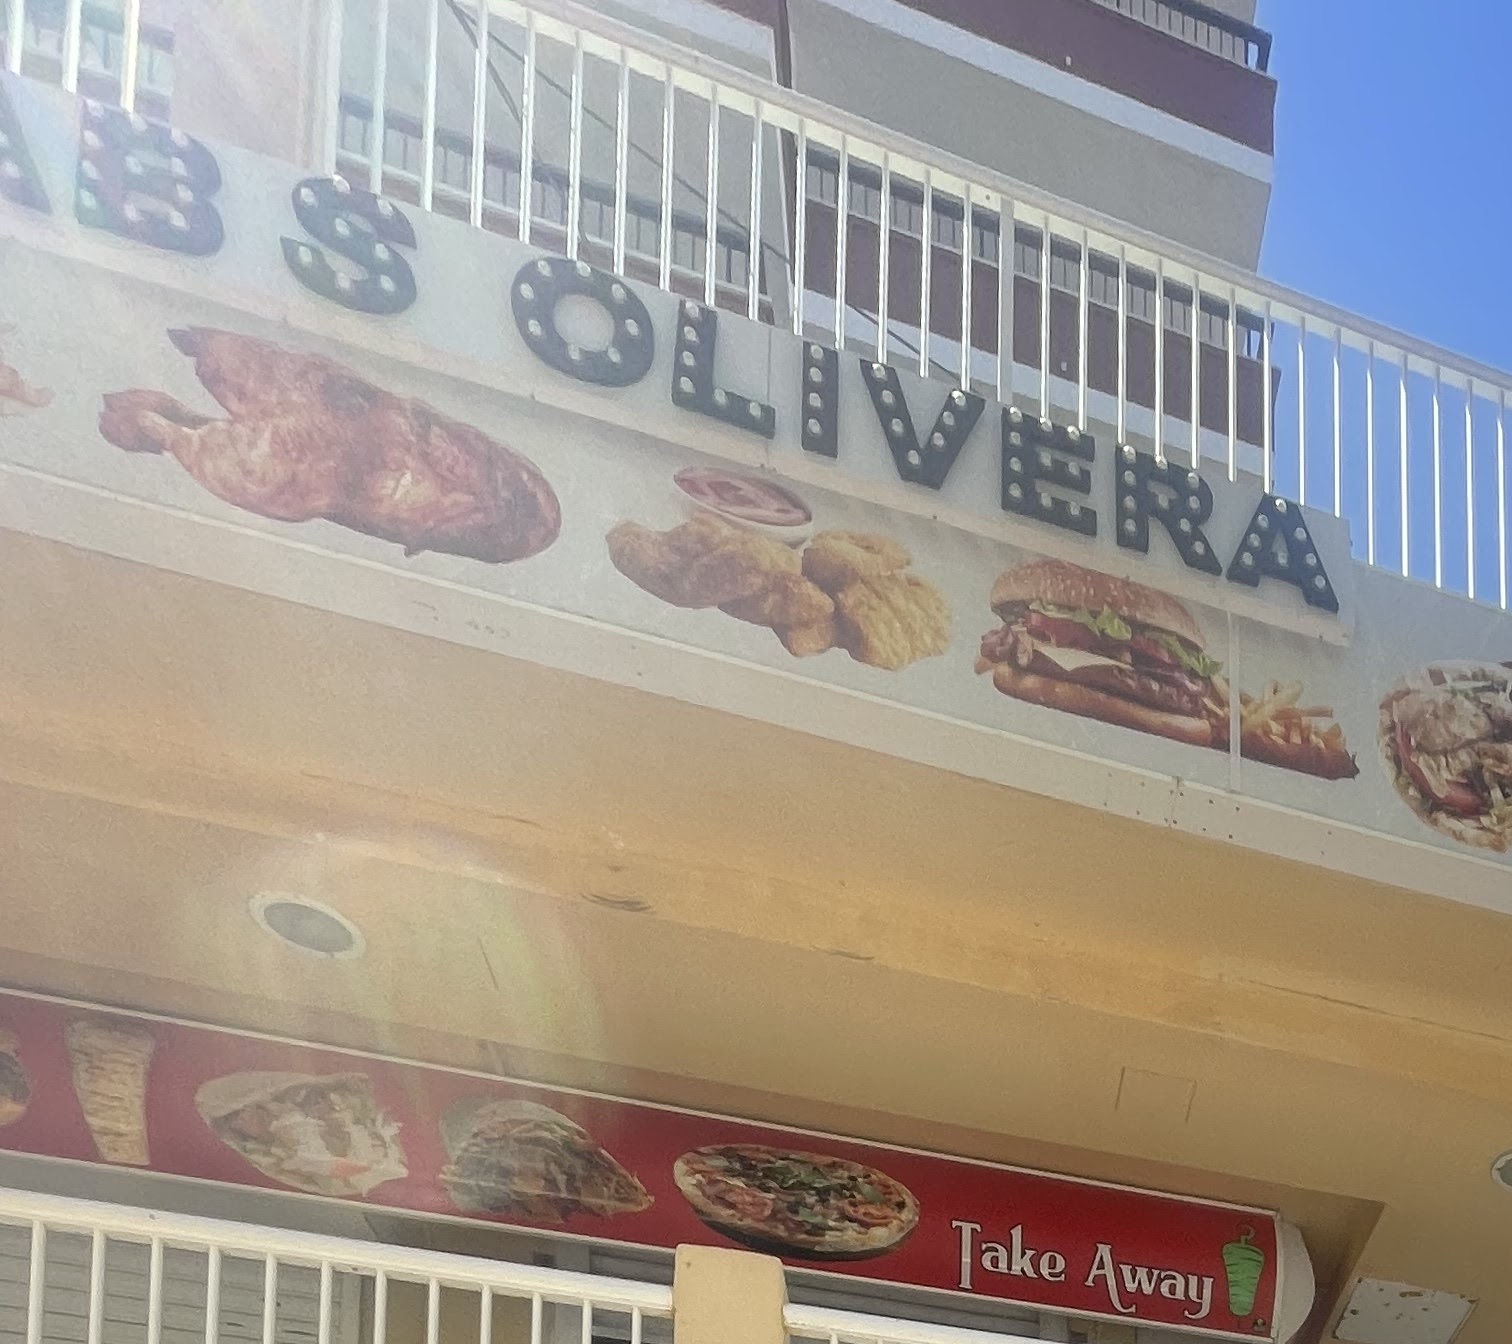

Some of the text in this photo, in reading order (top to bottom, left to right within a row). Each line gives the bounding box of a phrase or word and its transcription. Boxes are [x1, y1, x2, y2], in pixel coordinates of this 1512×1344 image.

[510, 253, 1340, 612] OLIVERA
[952, 1220, 1214, 1319] Take Away
